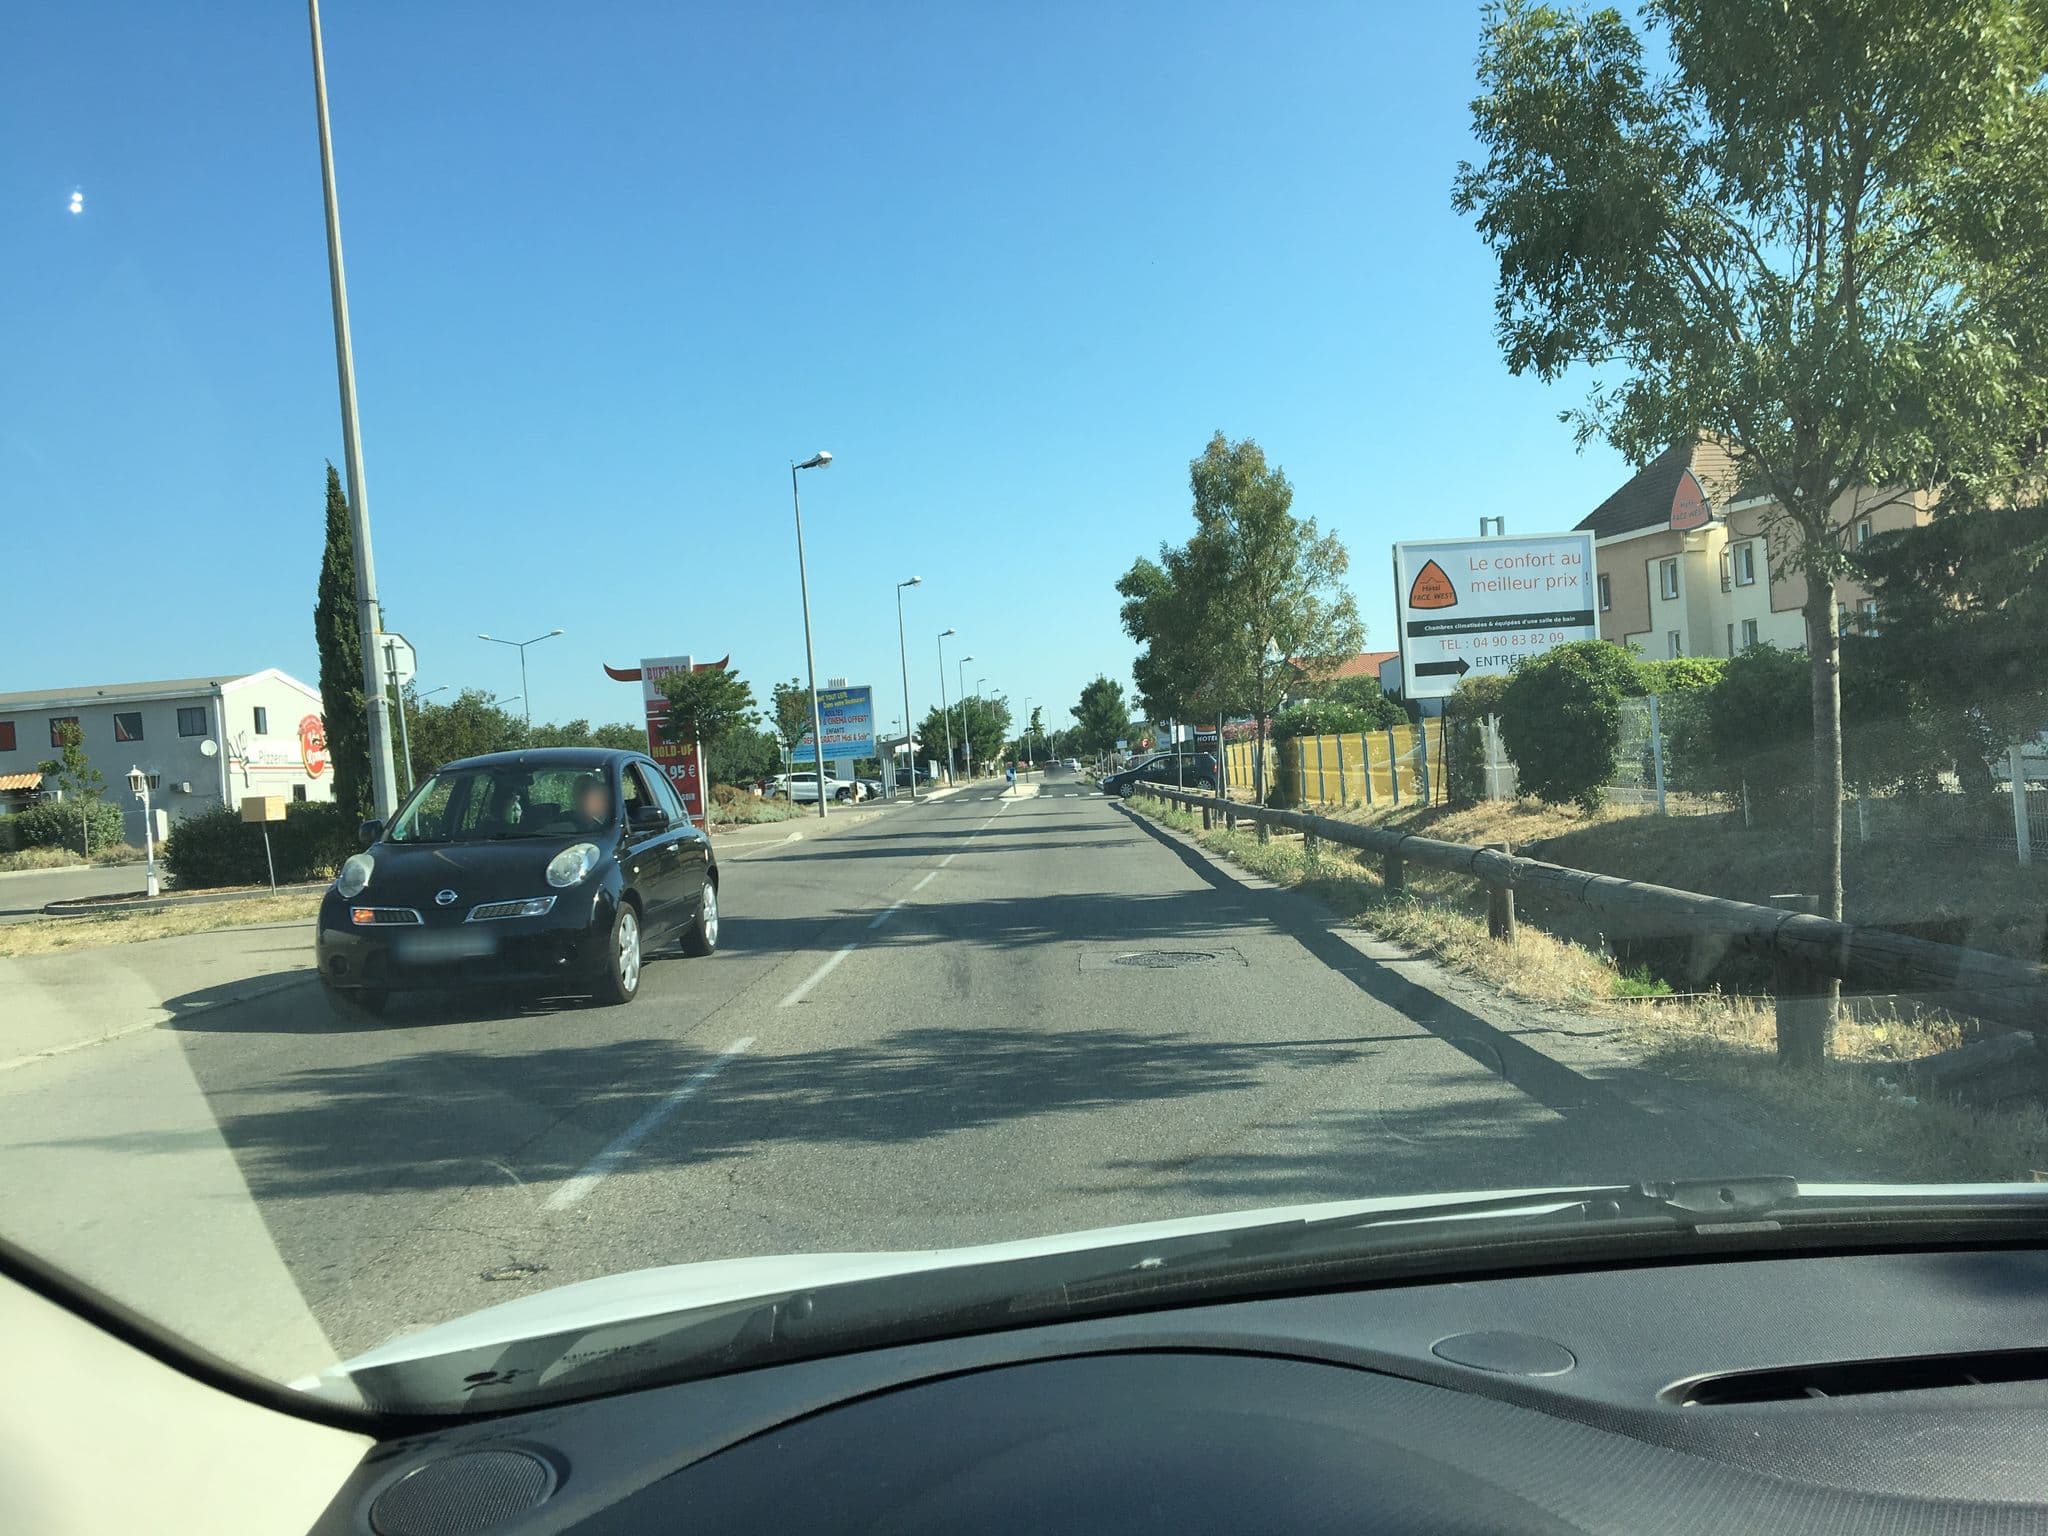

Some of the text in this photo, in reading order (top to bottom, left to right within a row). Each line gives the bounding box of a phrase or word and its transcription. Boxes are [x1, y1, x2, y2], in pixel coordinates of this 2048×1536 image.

[1469, 552, 1581, 571] Le confort au
[1471, 576, 1540, 593] meilleur
[1546, 573, 1578, 590] prix
[1434, 592, 1453, 600] WEST
[1424, 623, 1454, 631] Chambres
[1455, 621, 1488, 629] climatisées
[1495, 619, 1521, 628] équipées
[1440, 639, 1462, 651] TEL
[1473, 637, 1488, 648] 04
[1492, 635, 1507, 647] 90
[1511, 634, 1526, 646] 83
[1530, 633, 1545, 645] 82
[1549, 631, 1564, 643] 09
[688, 764, 696, 778] €
